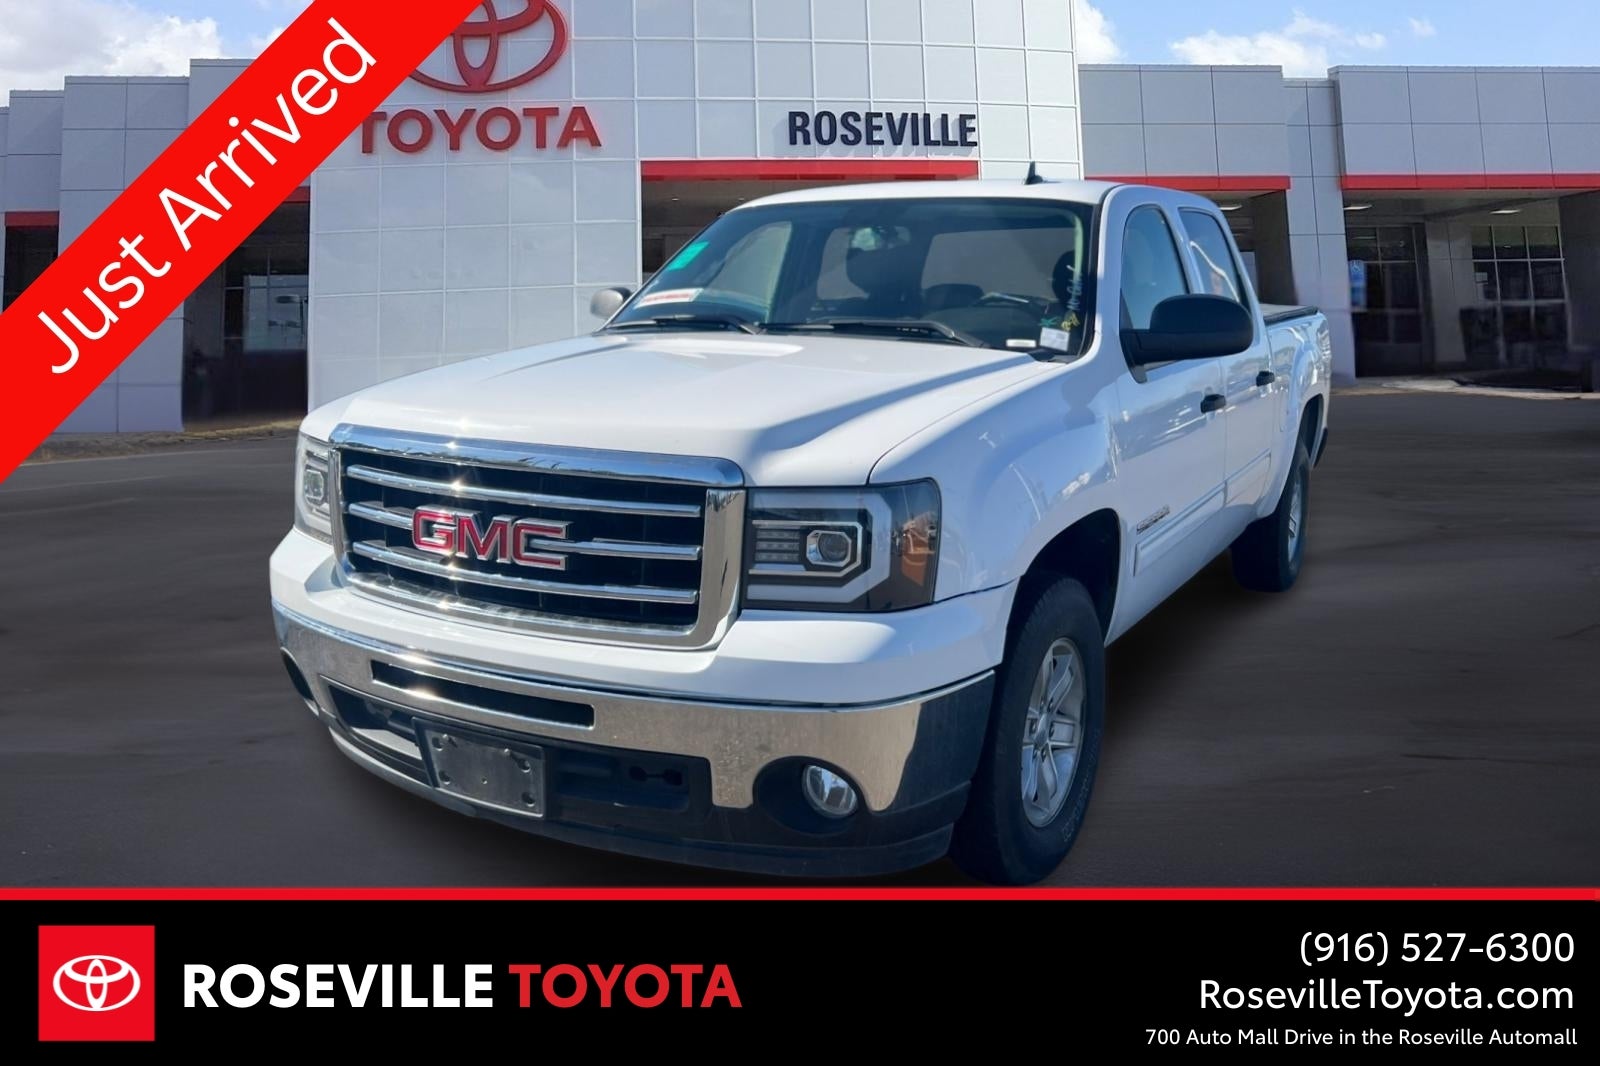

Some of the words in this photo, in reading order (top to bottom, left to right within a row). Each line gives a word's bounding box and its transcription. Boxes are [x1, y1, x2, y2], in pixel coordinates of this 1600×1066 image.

[361, 106, 602, 153] TOYOTA
[788, 110, 978, 147] ROSEVILLE
[411, 505, 574, 571] GMC
